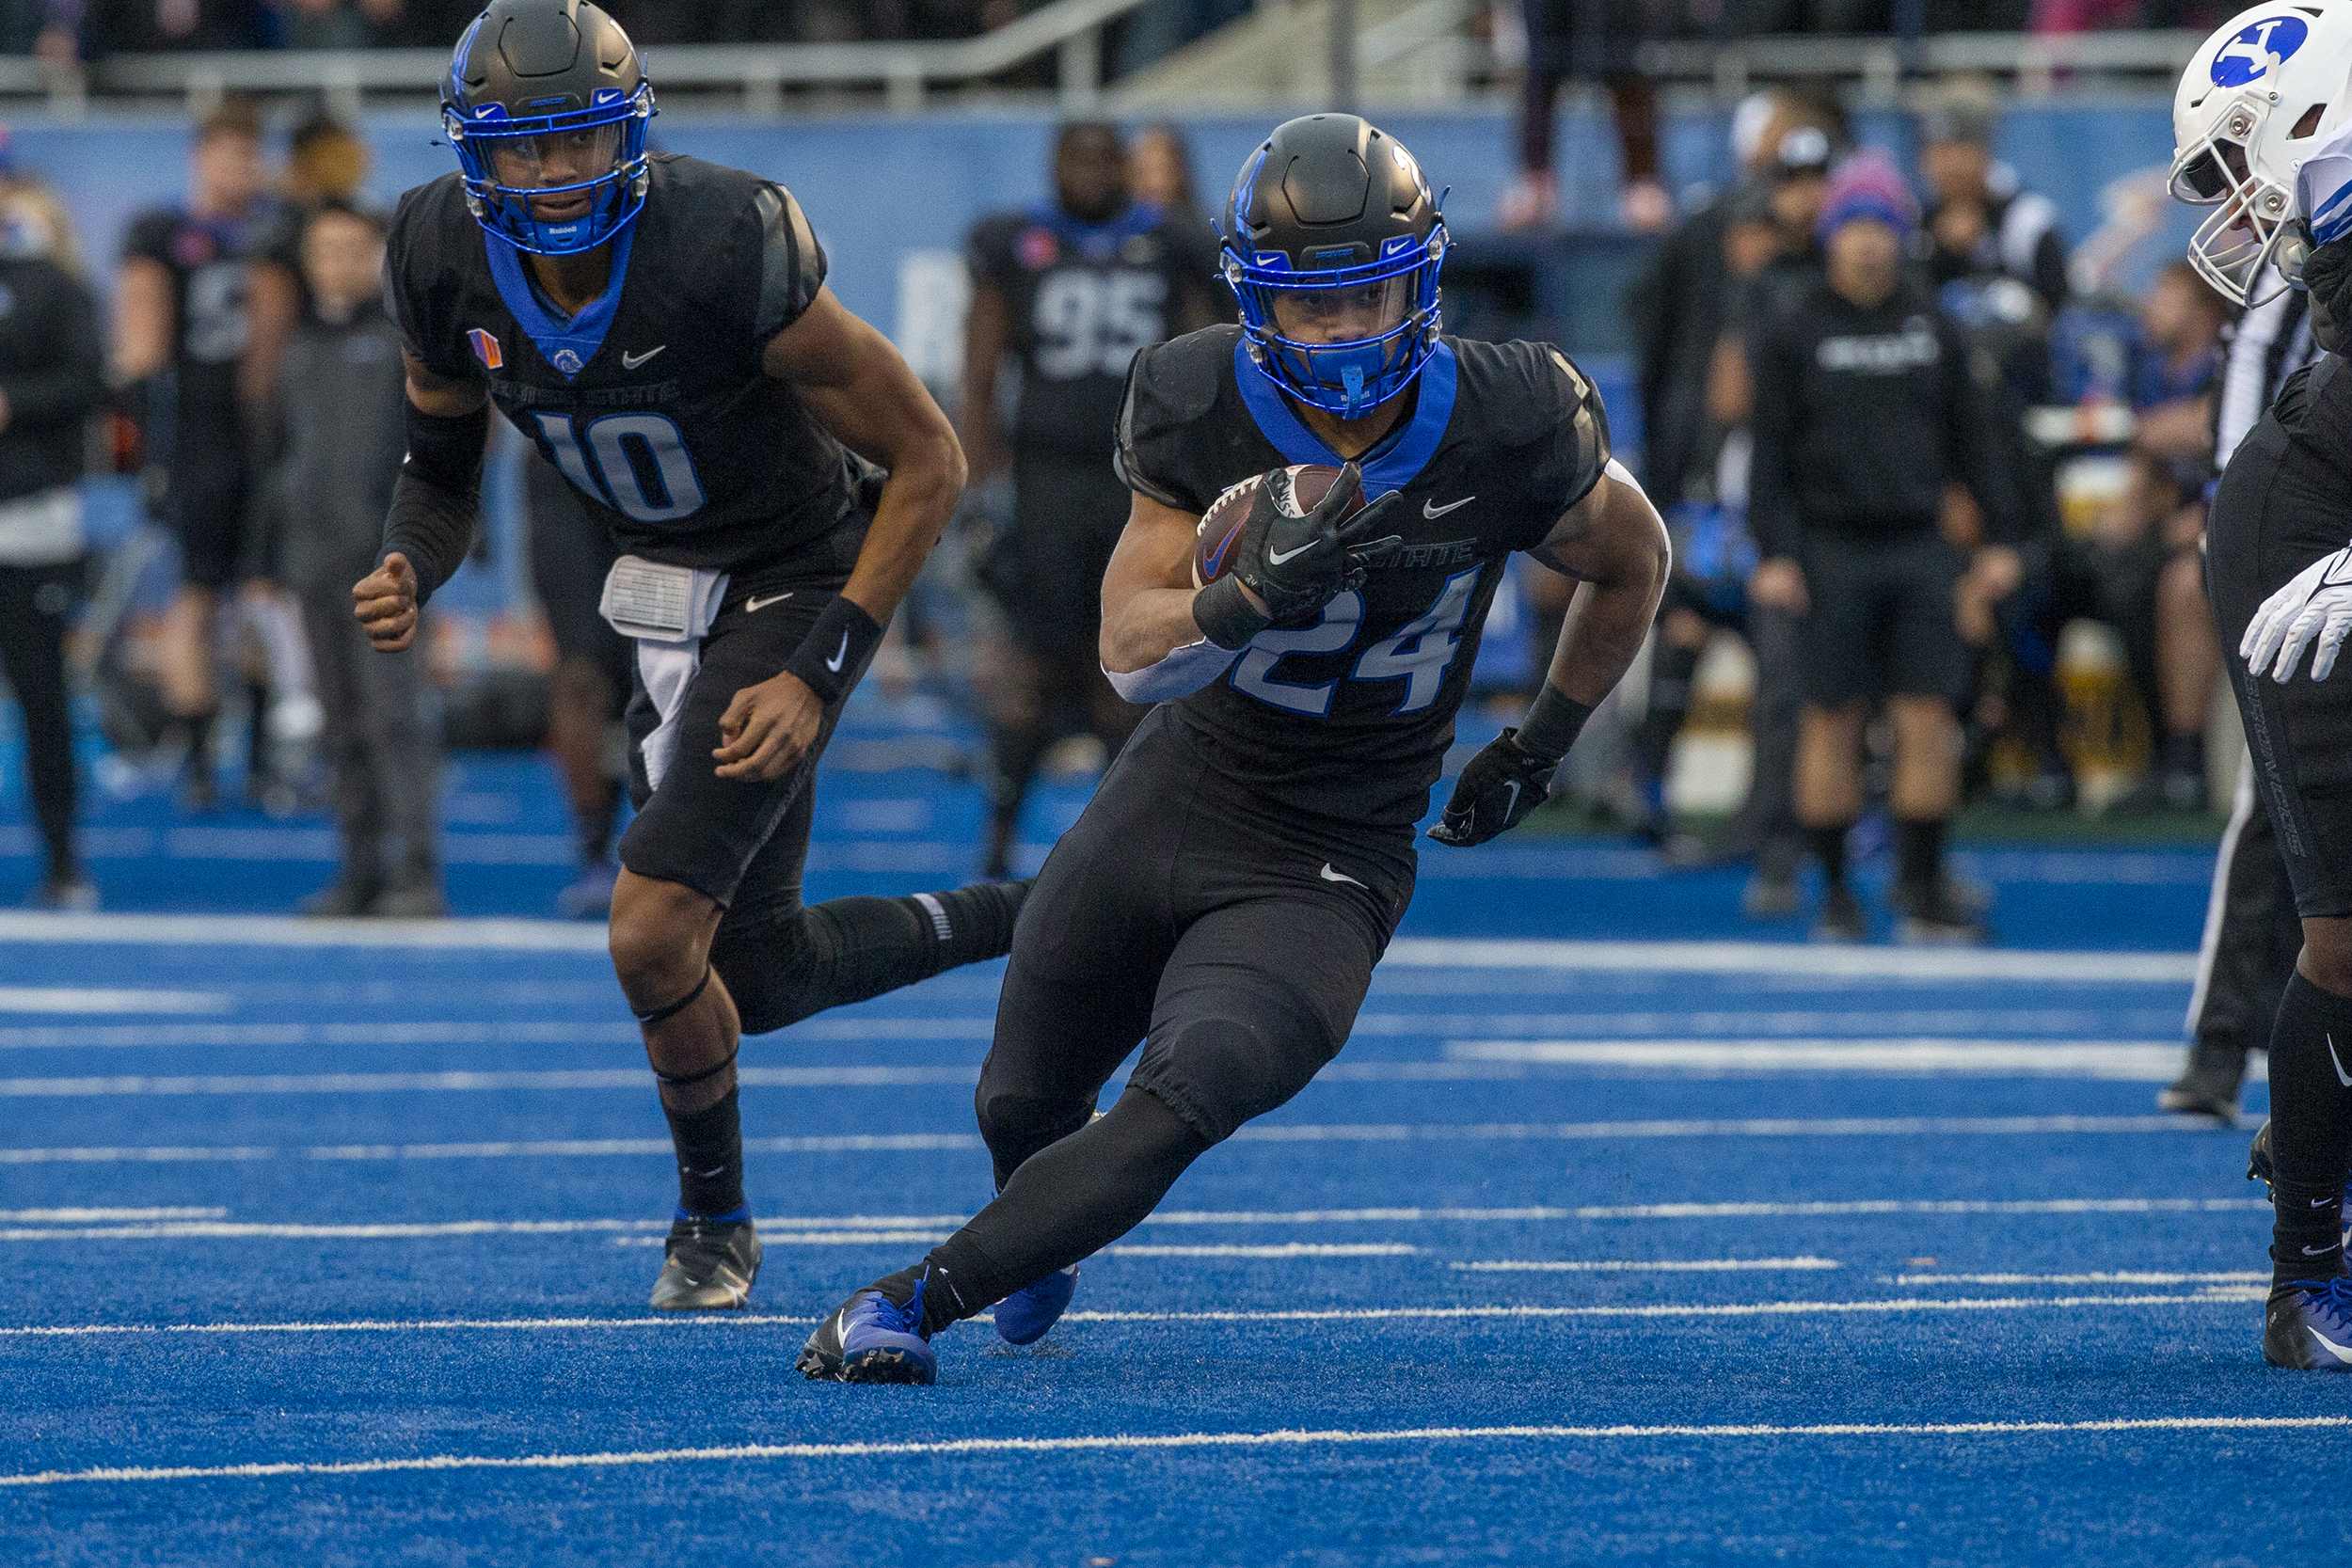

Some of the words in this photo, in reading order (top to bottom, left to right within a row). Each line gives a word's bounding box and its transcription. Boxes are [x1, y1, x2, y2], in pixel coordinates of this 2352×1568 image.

[2217, 21, 2282, 74] Y
[548, 226, 578, 235] Riddell
[1033, 268, 1170, 380] 95
[526, 410, 708, 523] 10
[1232, 564, 1483, 718] 24
